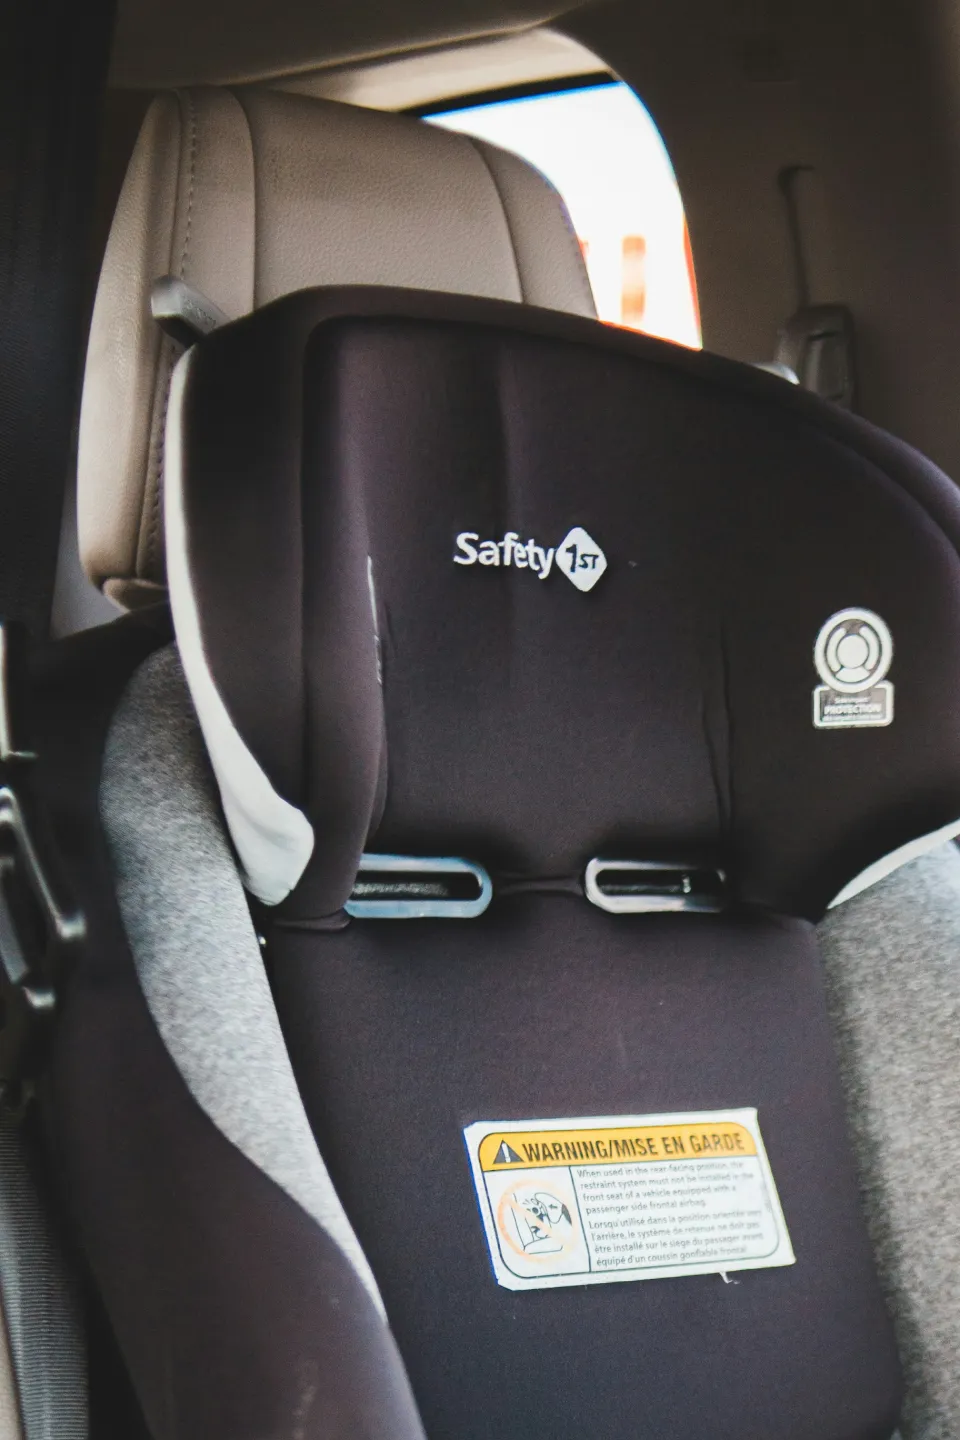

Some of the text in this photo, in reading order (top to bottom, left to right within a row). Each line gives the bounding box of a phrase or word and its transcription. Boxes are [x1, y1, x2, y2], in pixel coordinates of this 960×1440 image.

[453, 532, 554, 580] Safety
[521, 1132, 745, 1162] WARNING/MISE EN GARDE
[577, 1168, 601, 1178] When
[603, 1168, 623, 1176] used
[634, 1166, 648, 1175] the
[580, 1180, 615, 1190] restraint
[618, 1179, 647, 1190] system
[649, 1177, 669, 1185] must
[670, 1175, 685, 1184] not
[686, 1174, 697, 1183] be
[583, 1193, 604, 1202] front
[606, 1192, 623, 1200] seat
[625, 1190, 633, 1199] of
[642, 1188, 671, 1197] vehicle
[672, 1185, 711, 1197] equipped
[586, 1204, 628, 1216] passenger
[630, 1202, 648, 1211] side
[650, 1199, 677, 1209] frontal
[647, 1216, 667, 1225] dans
[668, 1214, 676, 1222] la
[678, 1212, 711, 1223] position
[628, 1230, 636, 1239] le
[637, 1228, 671, 1240] système
[613, 1241, 643, 1252] installé
[645, 1241, 658, 1250] sur
[660, 1238, 668, 1248] le
[692, 1237, 703, 1246] du
[704, 1234, 740, 1246] passager
[596, 1255, 626, 1267] équipé
[627, 1254, 646, 1264] d'un
[647, 1252, 678, 1262] coussin
